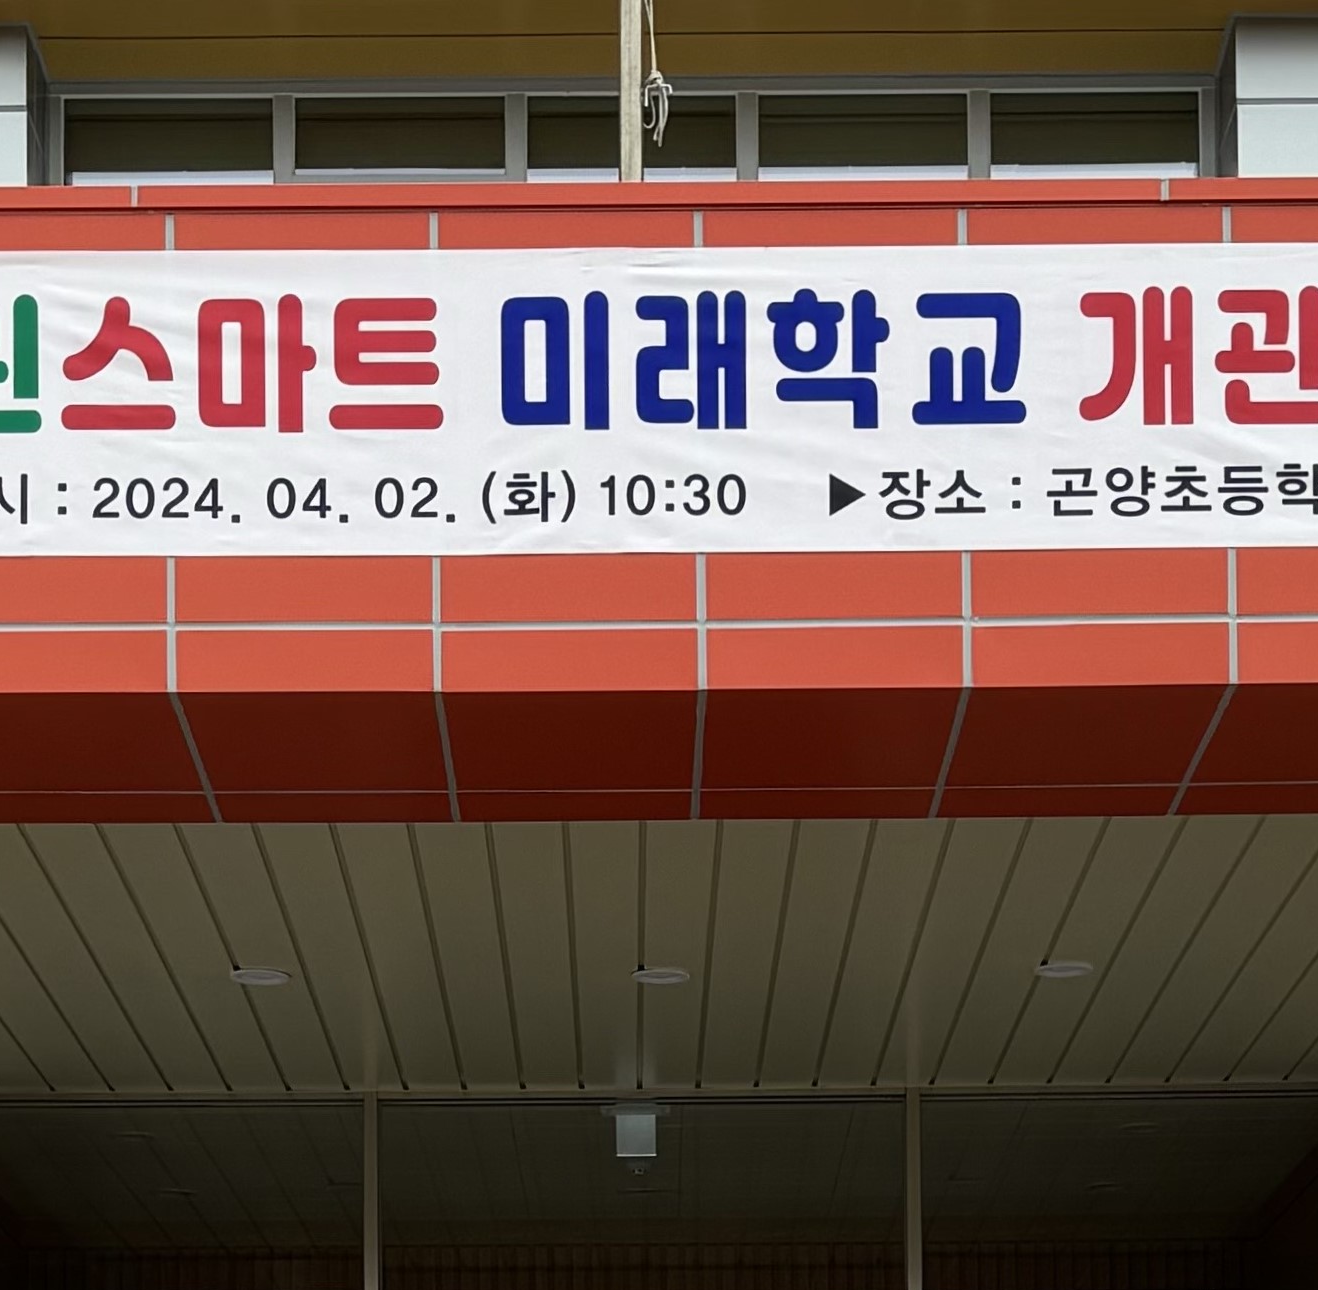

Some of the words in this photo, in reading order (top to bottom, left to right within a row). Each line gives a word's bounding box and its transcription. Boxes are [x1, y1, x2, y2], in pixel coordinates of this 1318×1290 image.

[501, 290, 1026, 429] 미래학교
[92, 477, 241, 524] 2024.
[266, 477, 349, 524] 04.
[374, 476, 456, 523] 02.
[482, 469, 576, 525] (화)
[600, 473, 747, 516] 10:30
[878, 468, 986, 521] 장소
